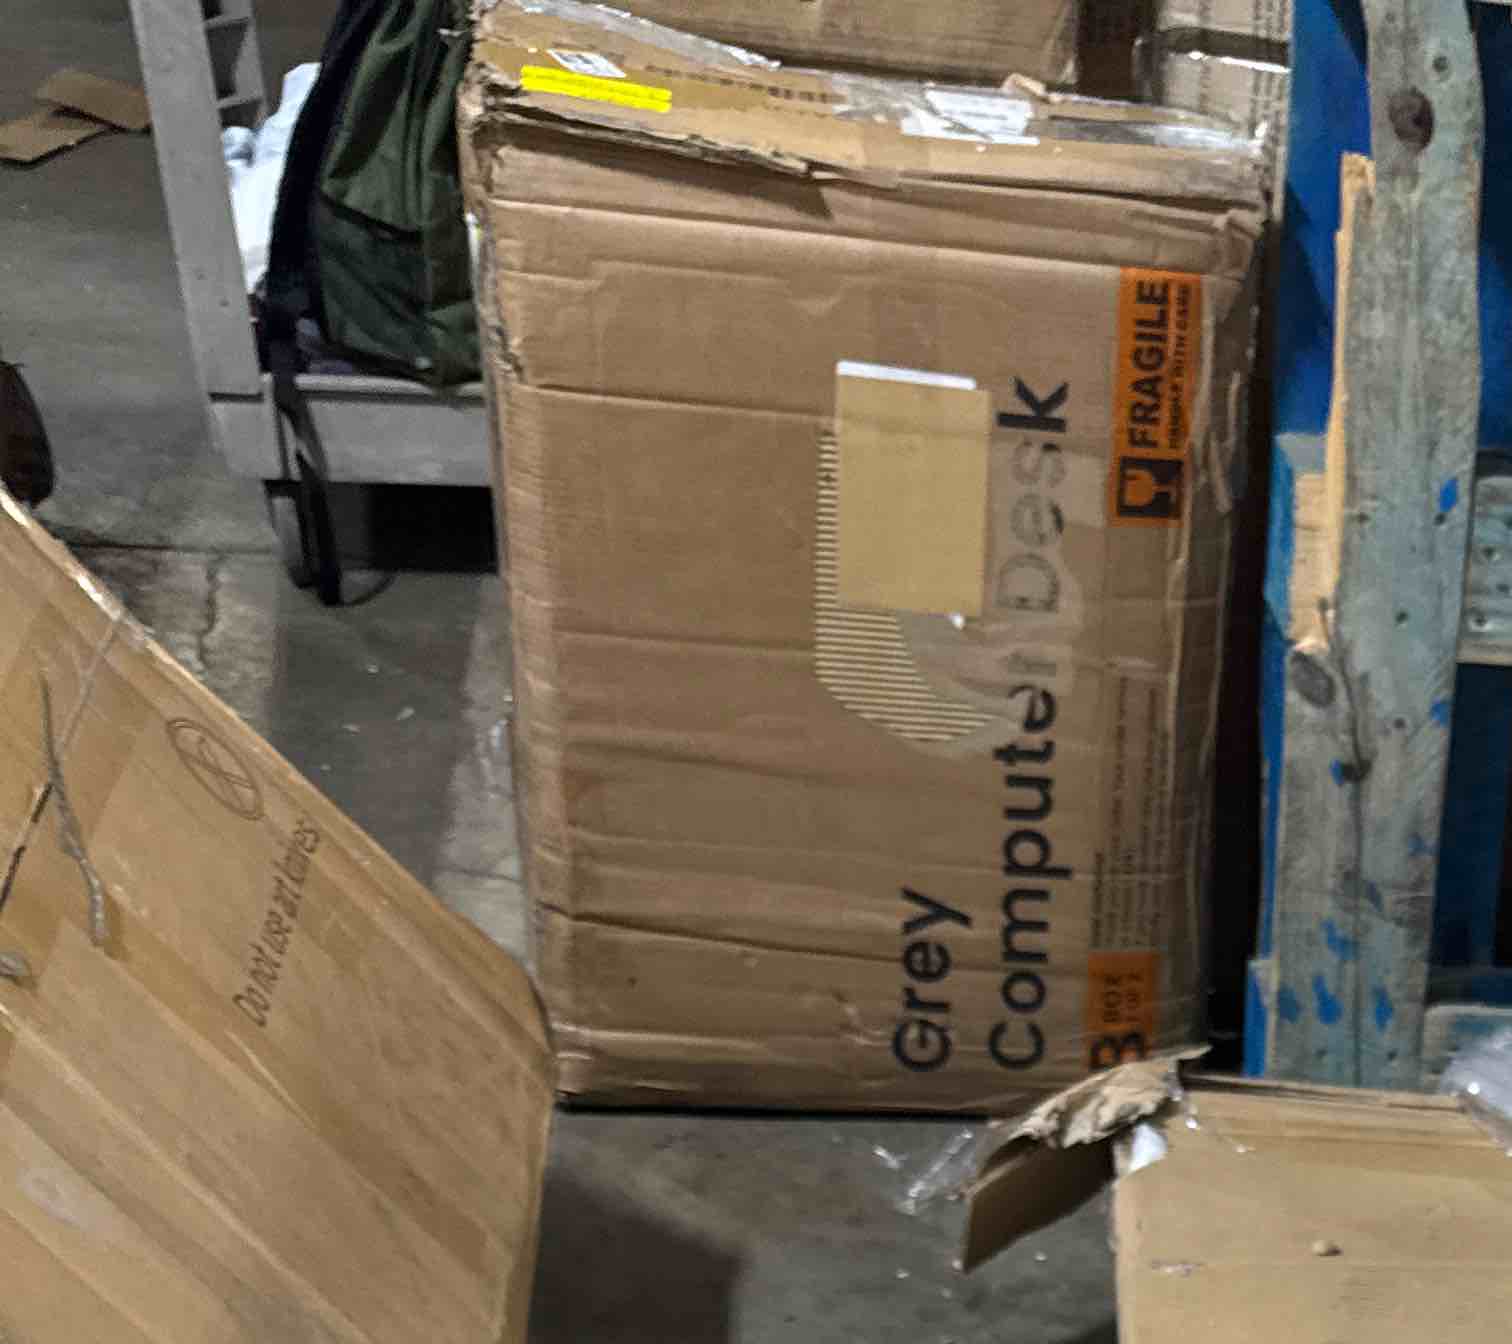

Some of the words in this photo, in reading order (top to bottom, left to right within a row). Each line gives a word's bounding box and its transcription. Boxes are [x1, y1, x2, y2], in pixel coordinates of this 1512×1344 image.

[1129, 279, 1169, 449] FRAGILE
[996, 376, 1069, 613] Desk
[892, 885, 972, 1072] Grey
